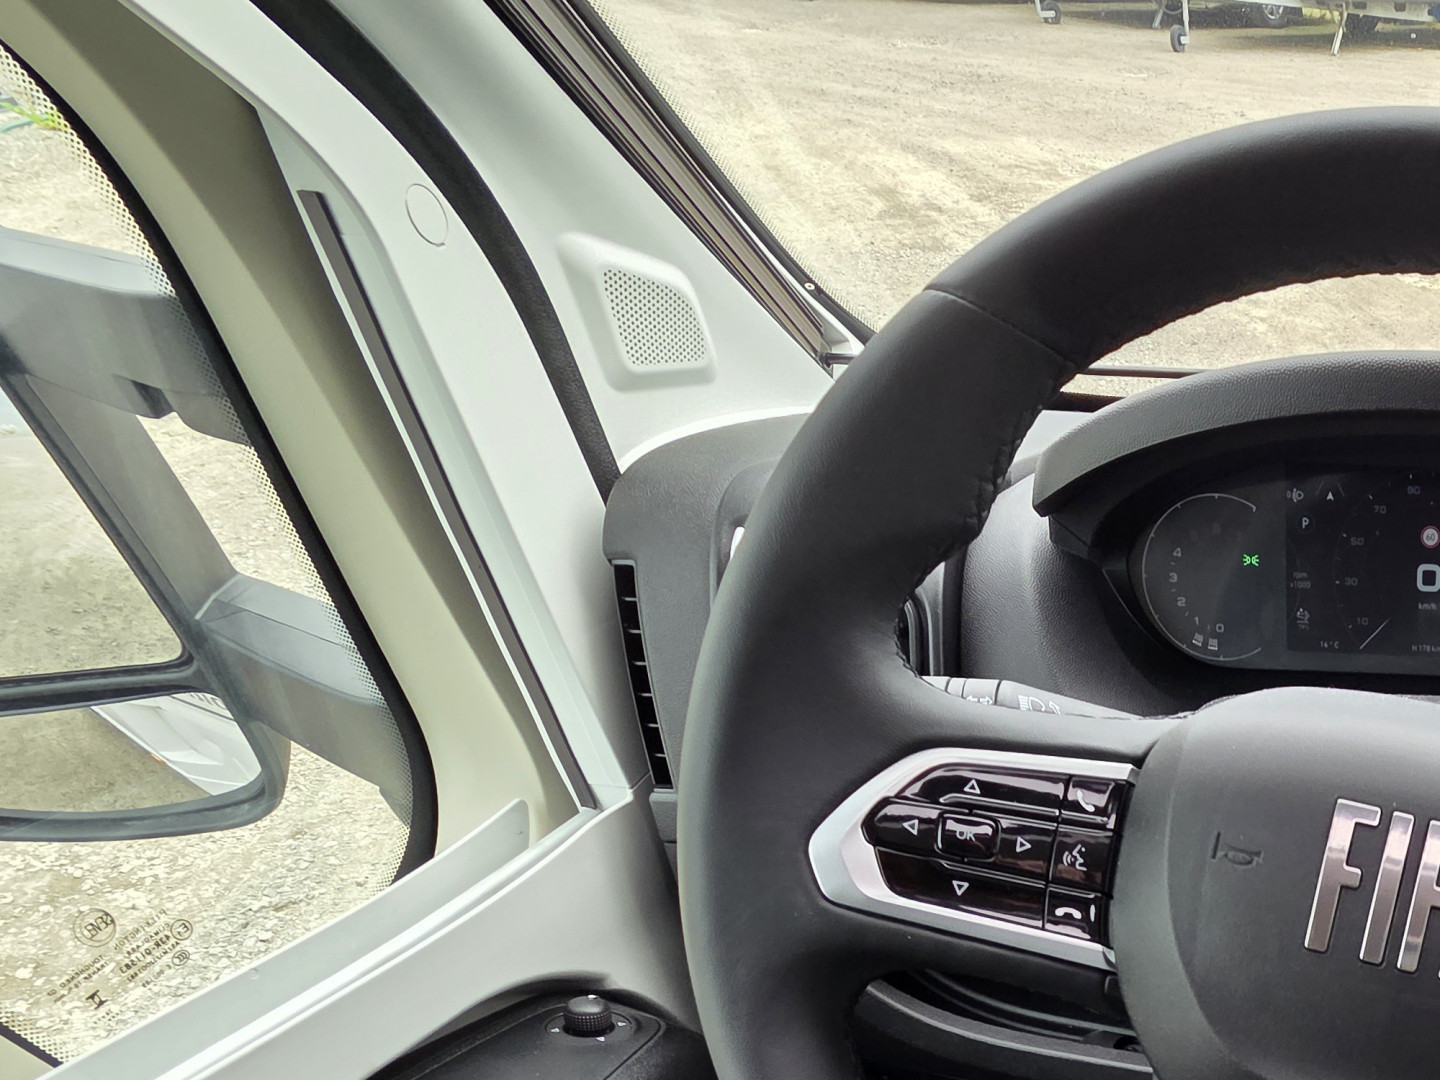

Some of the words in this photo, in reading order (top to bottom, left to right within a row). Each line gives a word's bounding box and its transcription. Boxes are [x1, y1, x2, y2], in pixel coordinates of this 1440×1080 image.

[1373, 505, 1387, 515] 70
[1301, 516, 1310, 529] P
[1350, 536, 1365, 546] 50
[1425, 532, 1436, 542] 60
[1172, 547, 1182, 557] 4
[1169, 572, 1178, 582] 3
[1344, 577, 1359, 586] 30
[1177, 597, 1186, 607] 2
[1418, 602, 1437, 611] km/h
[1356, 617, 1369, 626] 10
[1215, 623, 1224, 633] 0
[956, 829, 976, 842] OK
